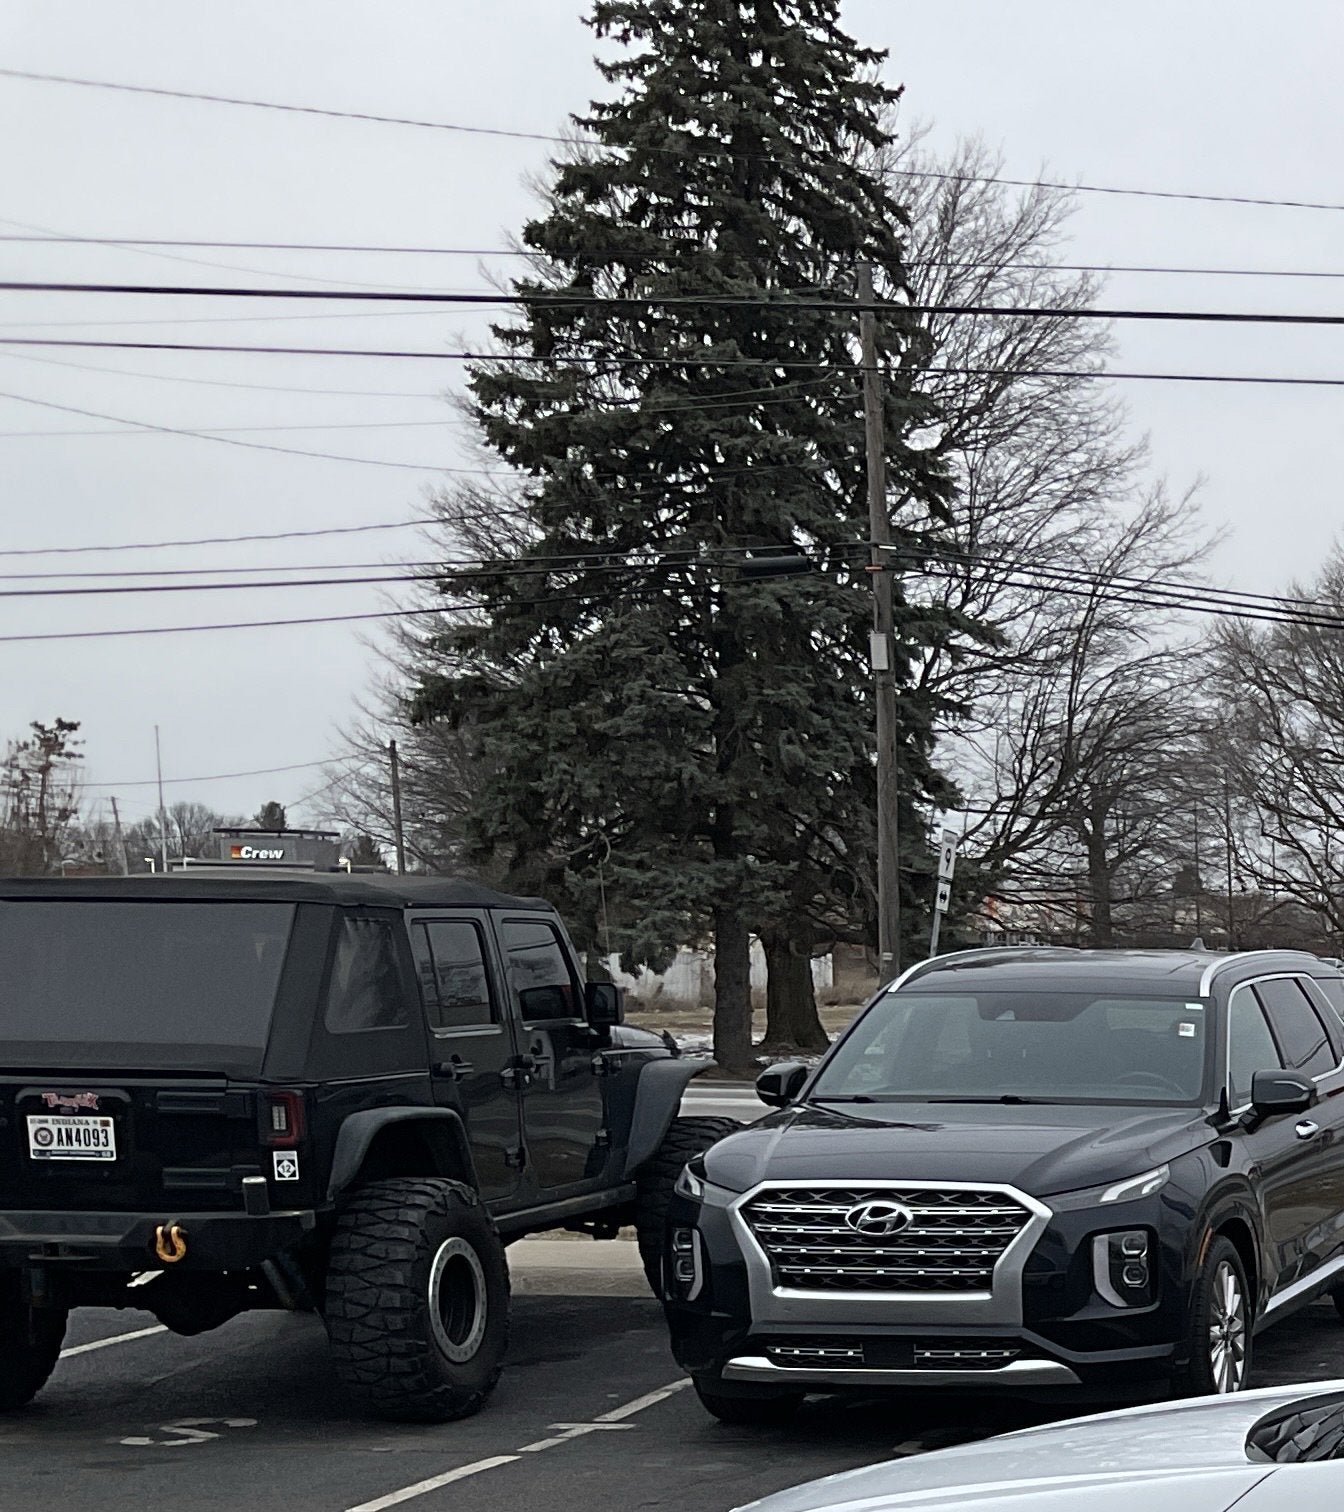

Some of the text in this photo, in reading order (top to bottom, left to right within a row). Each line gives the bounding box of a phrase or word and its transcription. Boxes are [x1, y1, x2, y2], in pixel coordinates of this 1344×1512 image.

[240, 846, 284, 859] Crew
[52, 1118, 90, 1126] INDIANA
[57, 1128, 109, 1147] AN4093
[280, 1164, 291, 1174] 12
